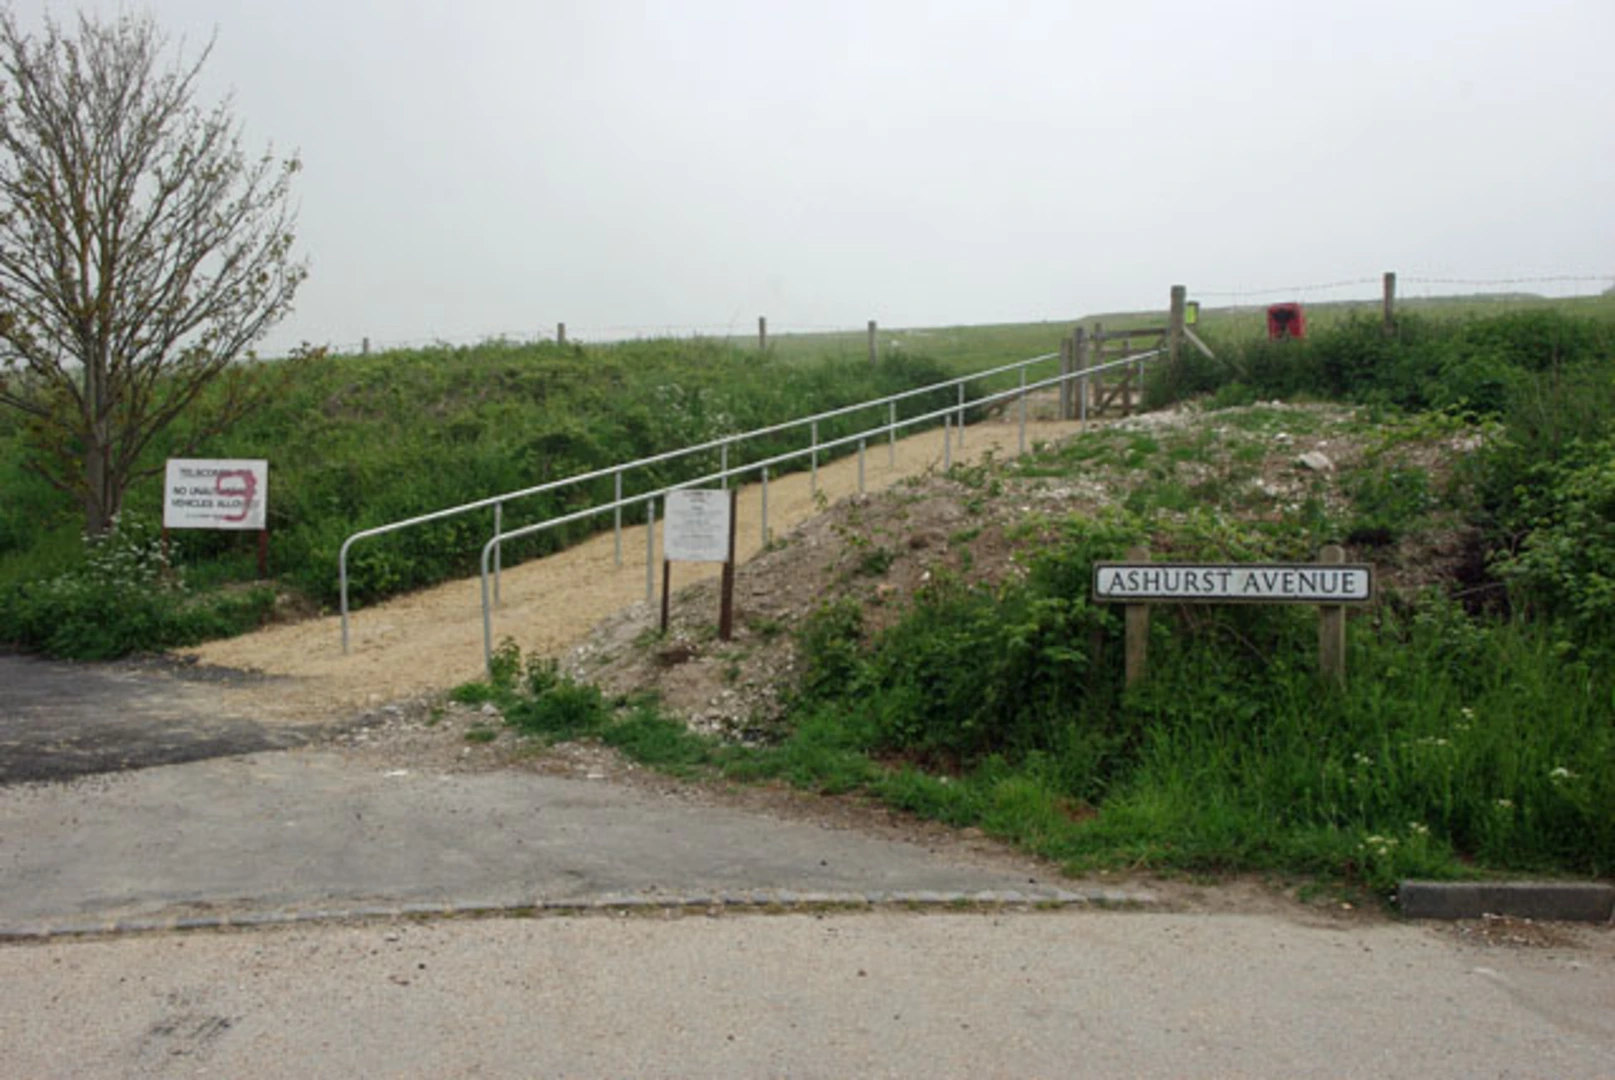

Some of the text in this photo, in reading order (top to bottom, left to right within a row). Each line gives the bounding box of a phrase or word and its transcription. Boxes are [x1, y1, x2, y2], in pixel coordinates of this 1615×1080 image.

[173, 486, 187, 495] NO
[171, 499, 213, 508] VEHICLES
[1109, 570, 1356, 594] ASHURST AVENUE
